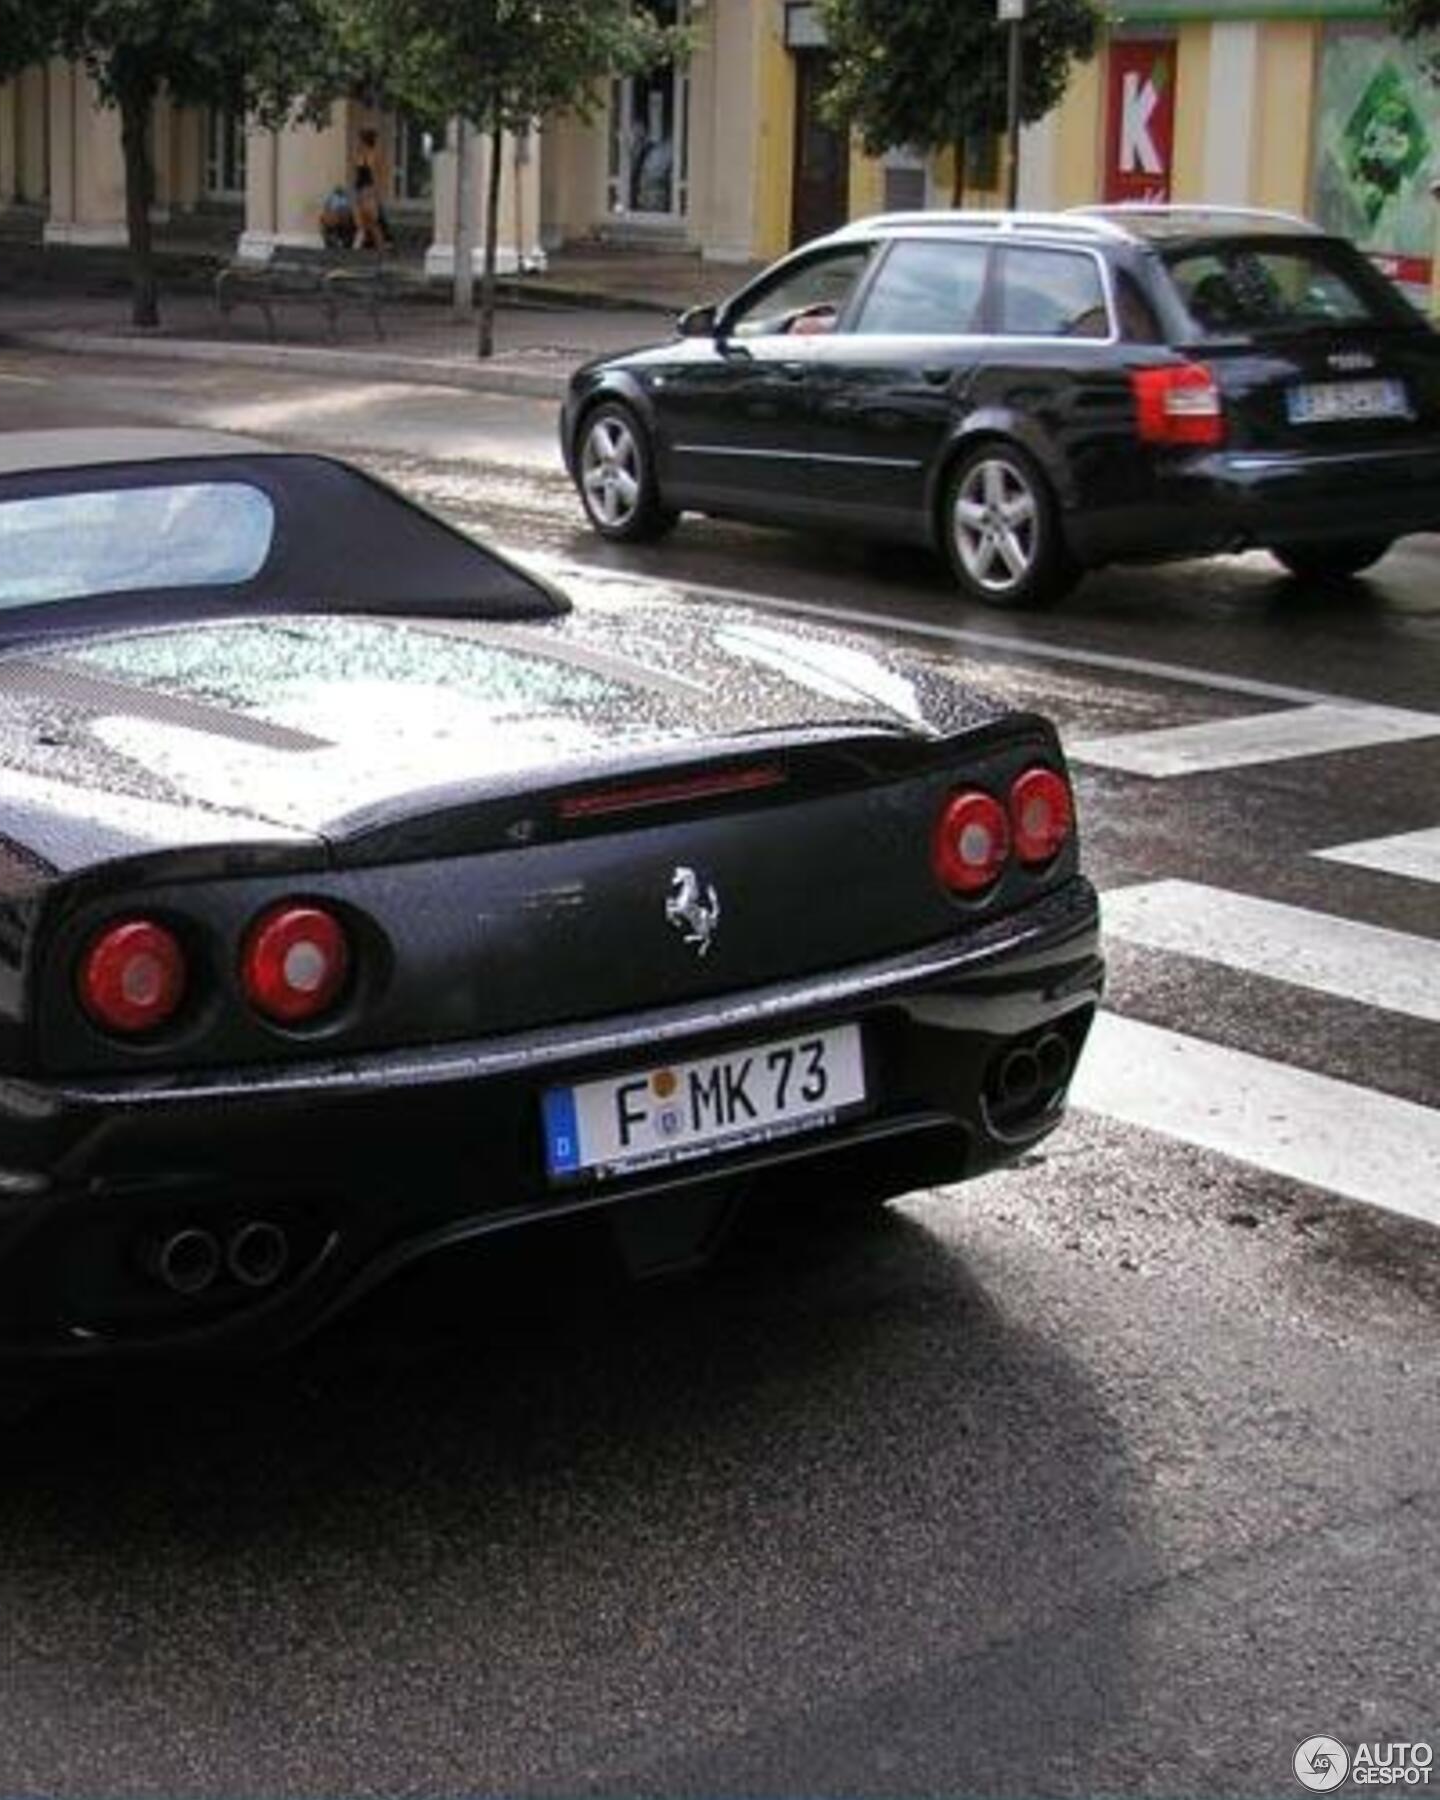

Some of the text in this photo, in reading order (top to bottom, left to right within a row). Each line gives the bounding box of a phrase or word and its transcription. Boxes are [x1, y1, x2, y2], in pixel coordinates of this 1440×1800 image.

[1120, 72, 1163, 173] K
[557, 1136, 570, 1157] D
[616, 1080, 648, 1145] F
[688, 1057, 758, 1131] MK
[767, 1039, 828, 1110] 73
